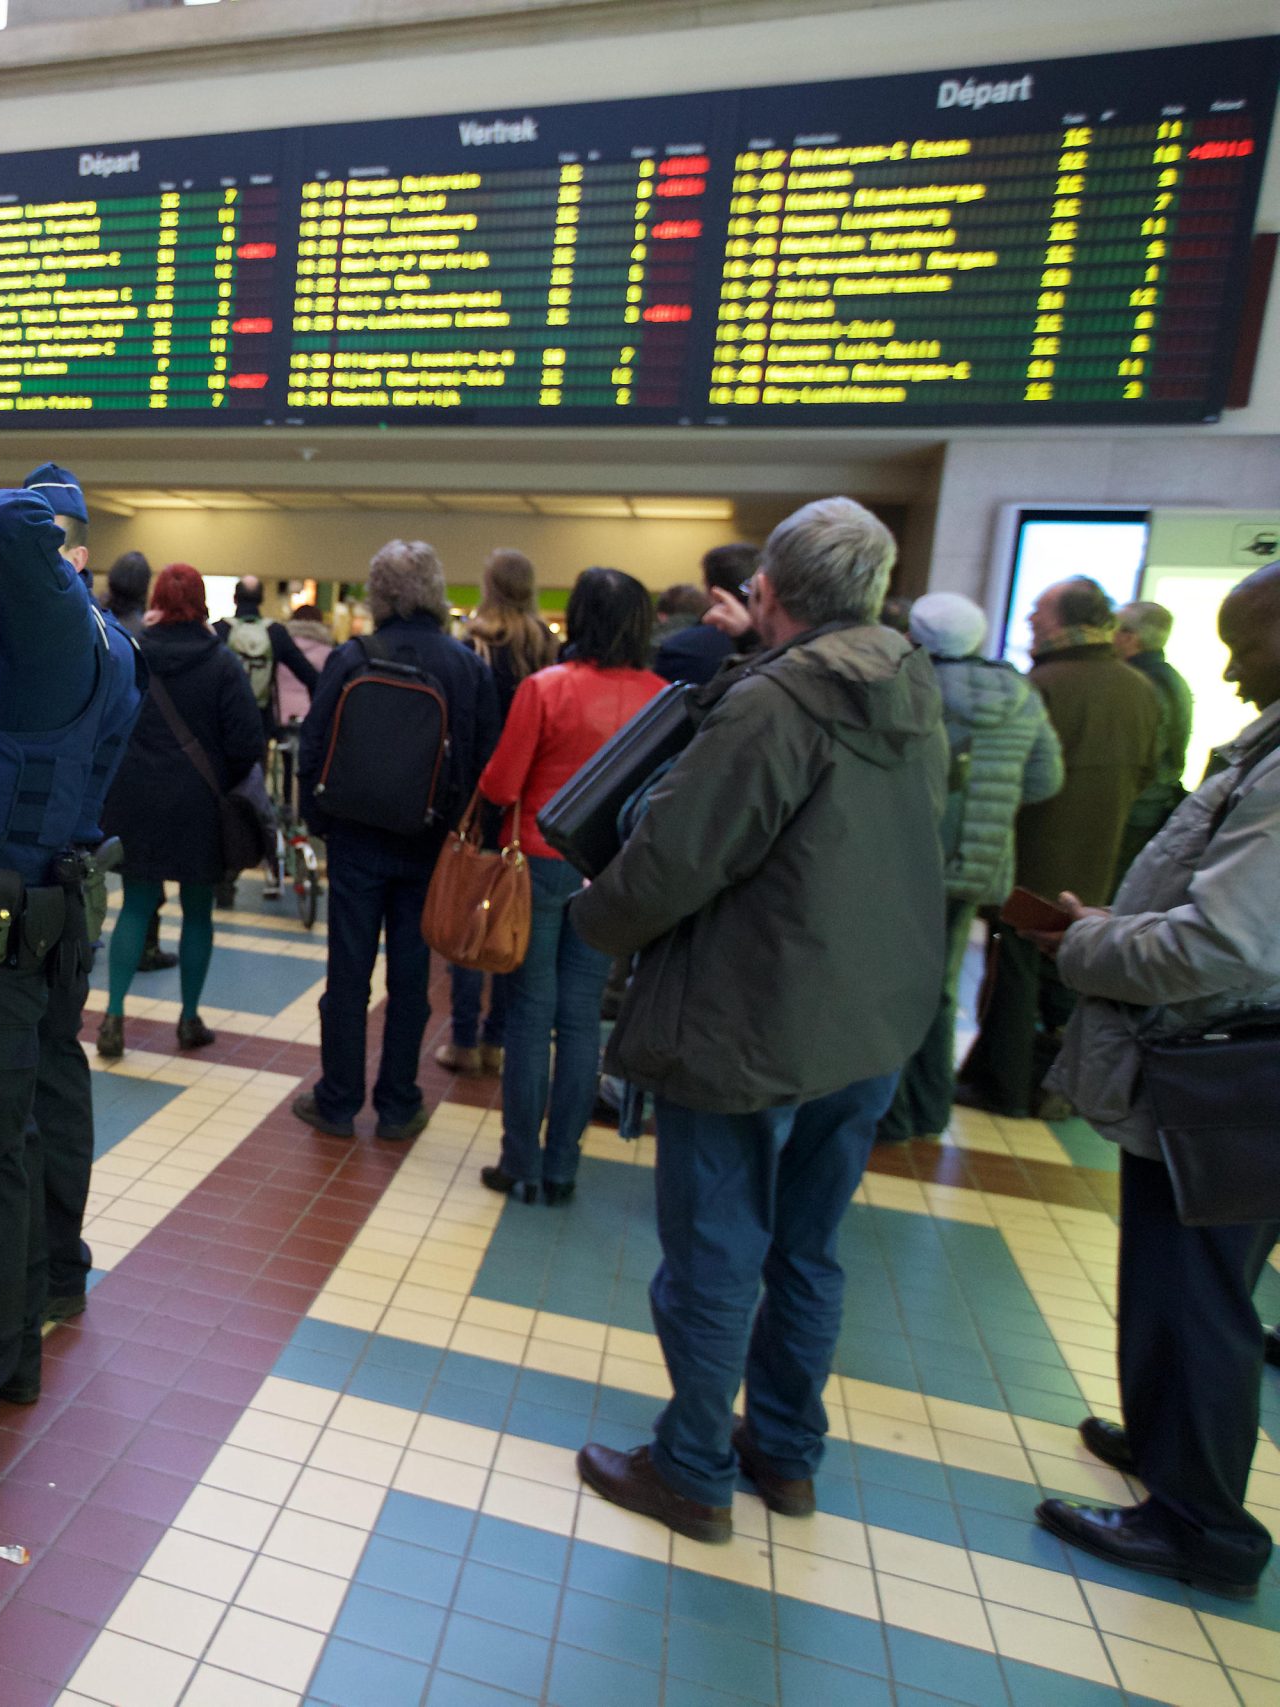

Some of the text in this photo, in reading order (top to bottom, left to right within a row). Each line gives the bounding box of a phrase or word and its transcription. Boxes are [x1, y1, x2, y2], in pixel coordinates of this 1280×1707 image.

[937, 73, 1034, 110] Départ
[459, 116, 539, 147] Vertrek
[78, 150, 141, 177] Départ
